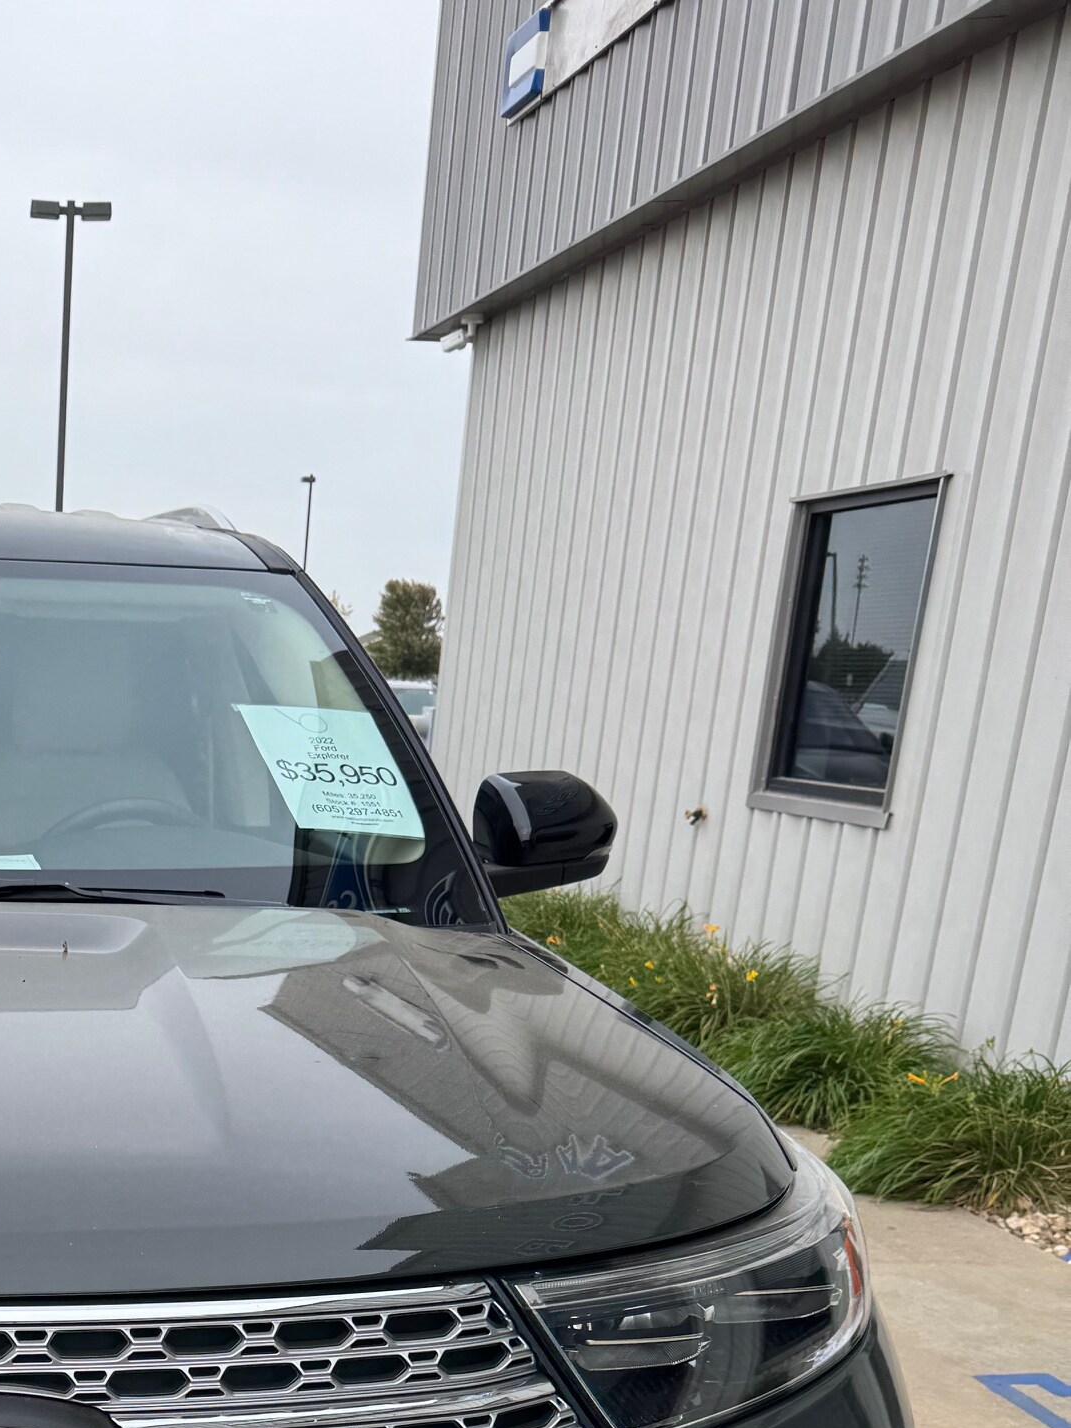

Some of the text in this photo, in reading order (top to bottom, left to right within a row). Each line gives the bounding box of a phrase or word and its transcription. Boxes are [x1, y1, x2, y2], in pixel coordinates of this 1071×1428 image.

[308, 736, 334, 744] 2022
[308, 752, 350, 761] Explorer
[276, 758, 398, 787] $35,950
[311, 804, 404, 818] (605) 297-4851
